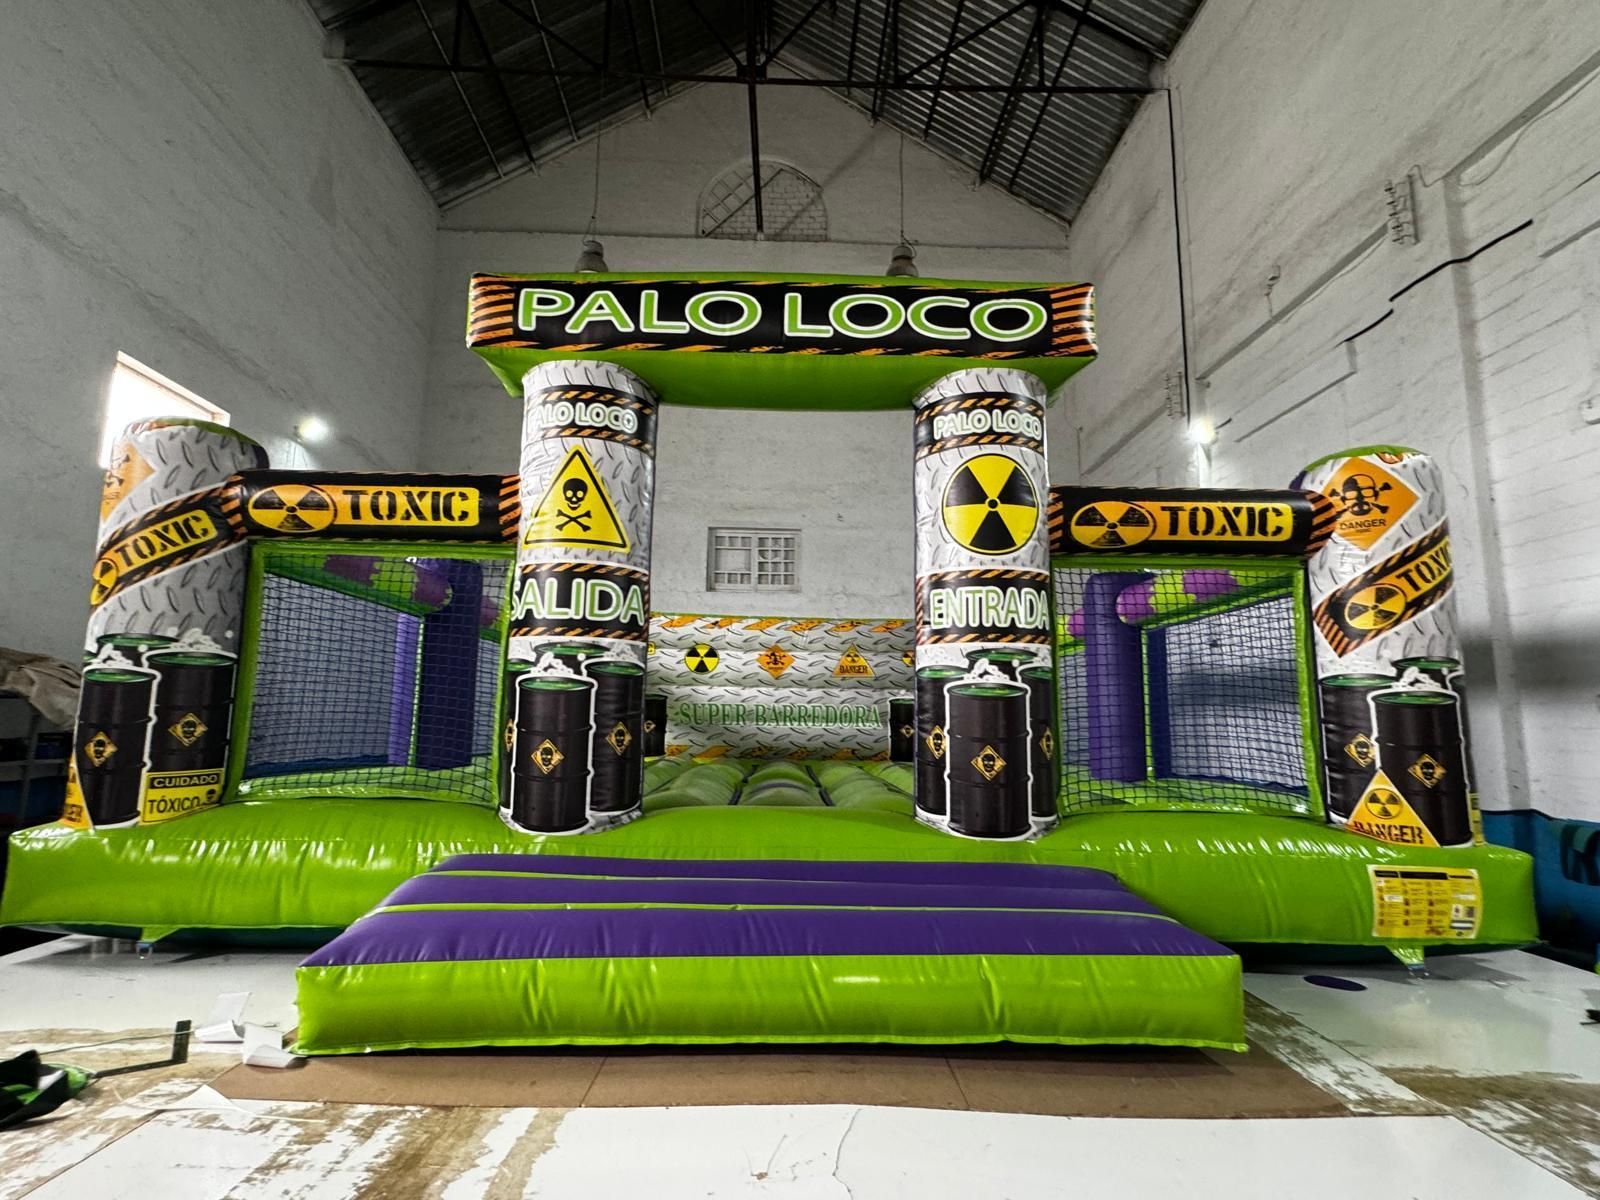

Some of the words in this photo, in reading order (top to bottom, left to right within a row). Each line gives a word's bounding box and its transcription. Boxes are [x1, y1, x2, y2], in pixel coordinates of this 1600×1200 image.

[518, 288, 762, 336] PALO
[784, 293, 1048, 342] LOCO
[575, 402, 638, 434] LOCO
[933, 409, 991, 440] PALO
[992, 409, 1042, 440] LOCO
[343, 489, 469, 522] TOXIC
[1160, 505, 1284, 537] TOXIC
[1340, 518, 1387, 530] DANGER
[114, 515, 210, 568] TOXIC
[930, 586, 1050, 630] ENTRADA
[678, 702, 747, 727] SUPER
[754, 703, 882, 729] BARREDORA
[154, 774, 218, 788] CUIDADO
